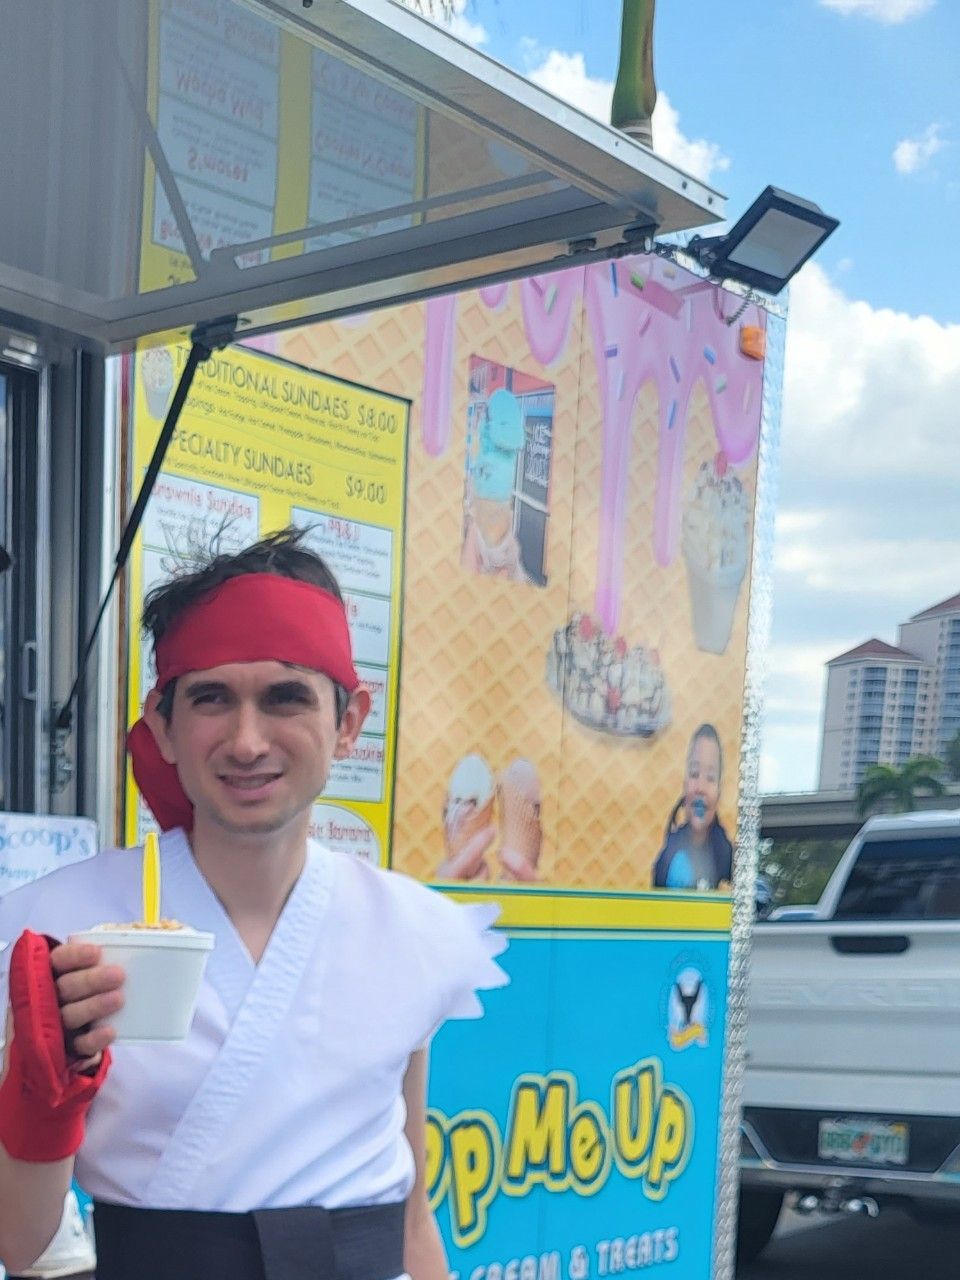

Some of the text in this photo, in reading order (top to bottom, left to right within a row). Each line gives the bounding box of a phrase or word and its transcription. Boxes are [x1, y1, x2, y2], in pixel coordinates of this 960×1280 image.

[176, 345, 279, 398] TADITIONAL
[281, 380, 351, 422] SUNDAES
[356, 403, 399, 436] $8.00
[169, 428, 241, 467] PECIALTY
[243, 448, 314, 486] SUNDAES
[345, 475, 387, 505] $9.00
[504, 1073, 609, 1195] Me
[614, 1060, 692, 1199] Up
[595, 1226, 680, 1277] TREATS
